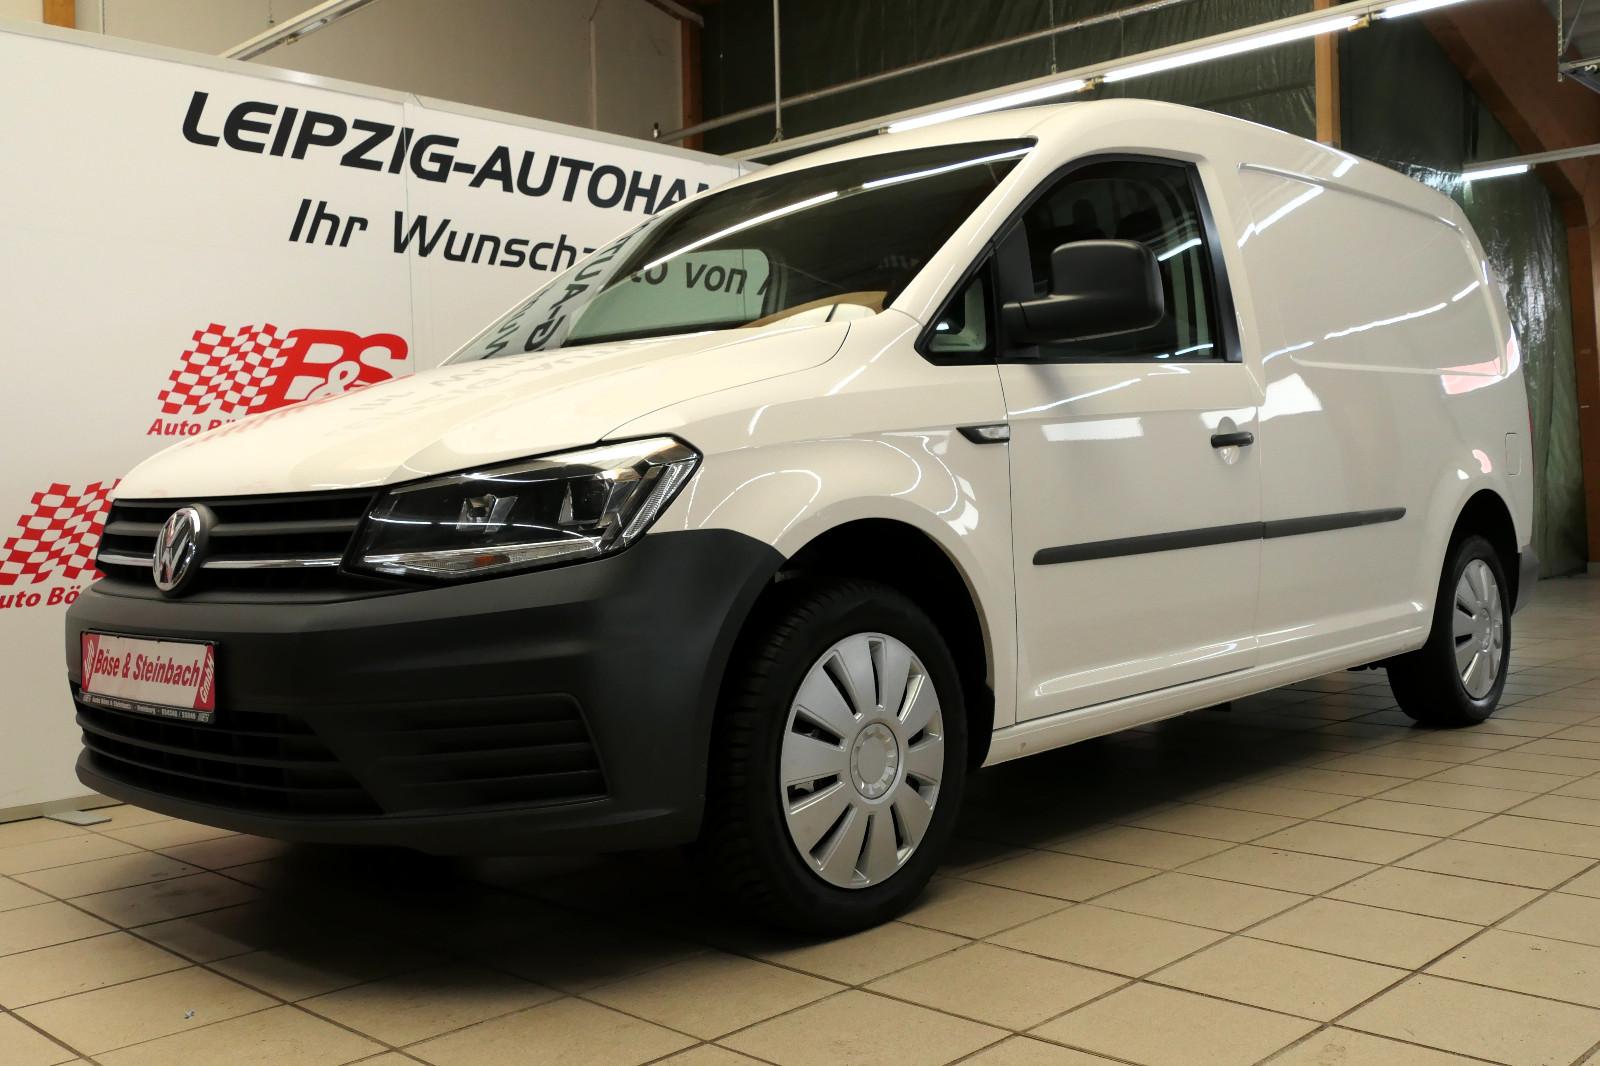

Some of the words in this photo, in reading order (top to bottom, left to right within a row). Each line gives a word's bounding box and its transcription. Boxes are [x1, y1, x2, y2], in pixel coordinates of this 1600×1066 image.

[182, 91, 710, 215] LEIPZIG-AUTOHA
[289, 198, 368, 246] Ihr
[393, 210, 600, 274] Wunsch
[685, 261, 748, 295] von
[146, 418, 202, 436] Auto
[0, 590, 42, 610] uto
[94, 648, 121, 677] Böse
[121, 652, 131, 679] &
[132, 653, 201, 688] Steinbach
